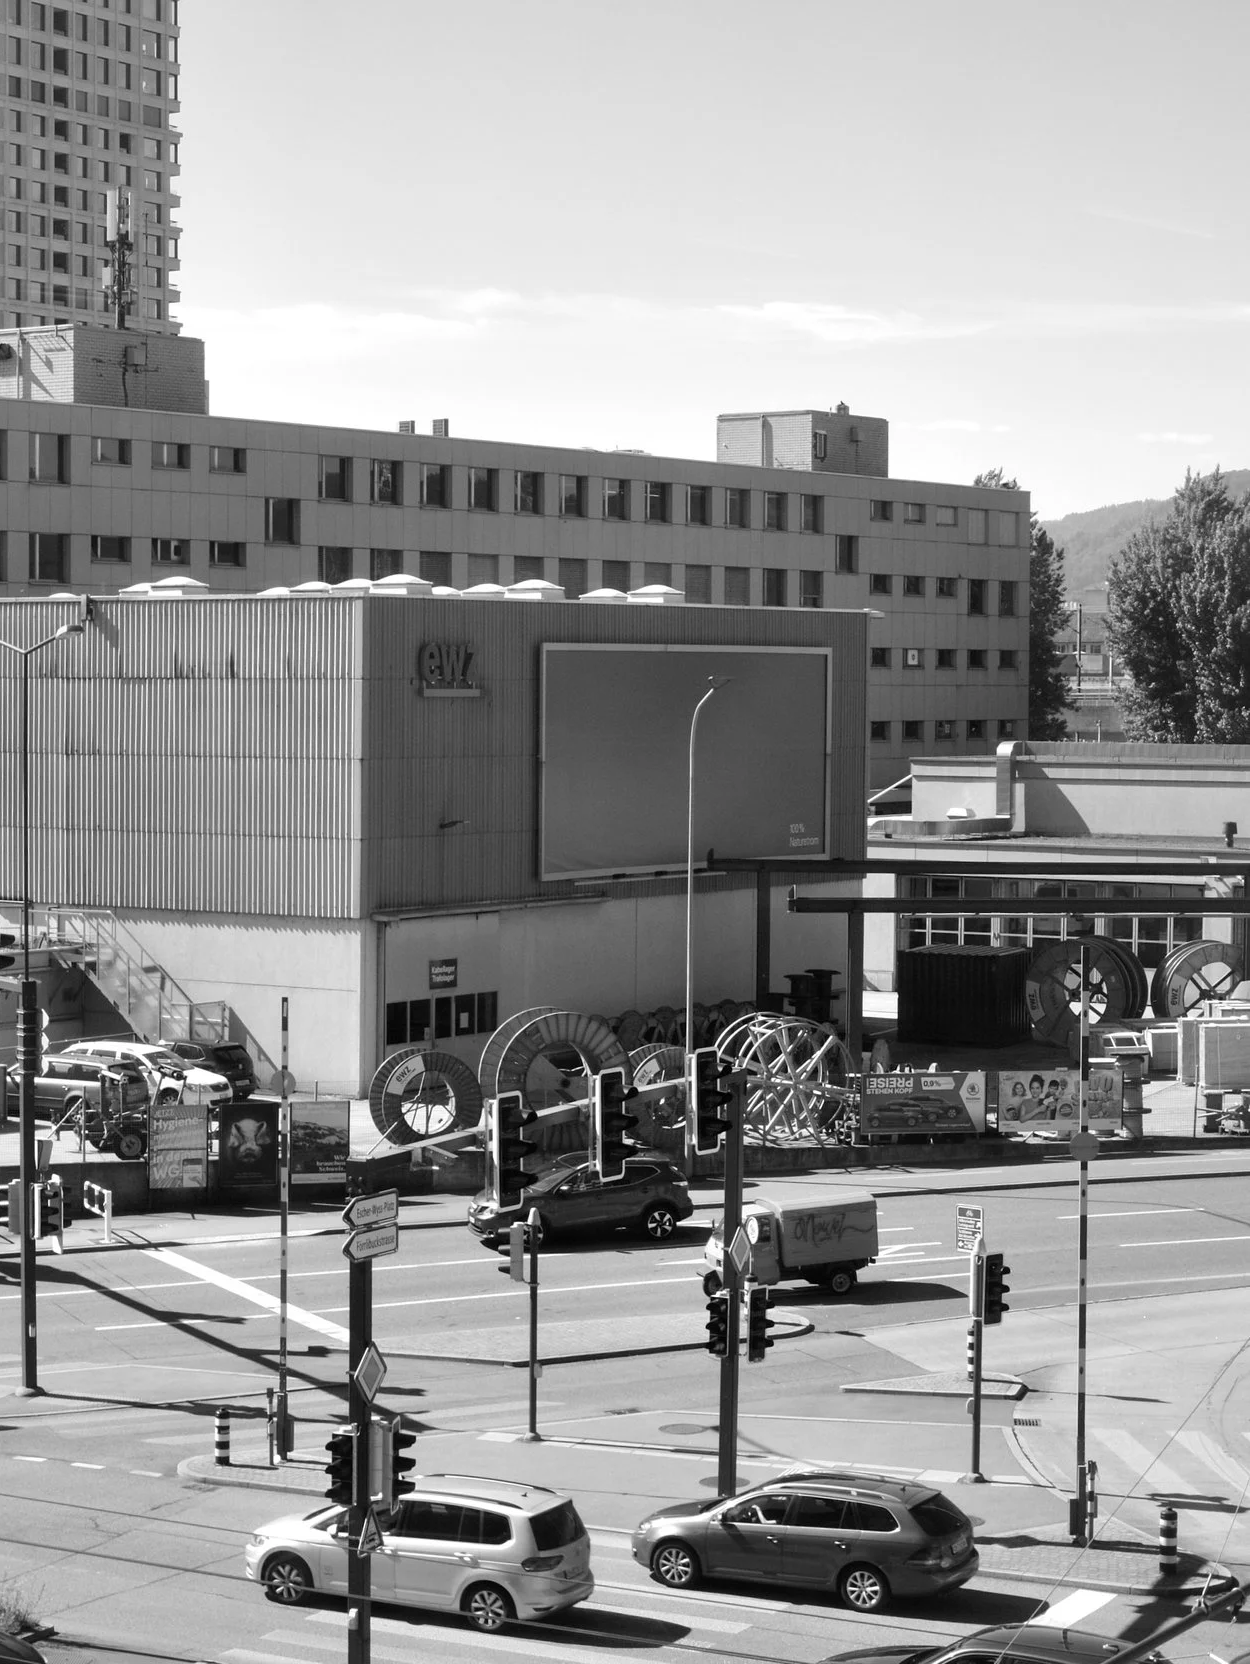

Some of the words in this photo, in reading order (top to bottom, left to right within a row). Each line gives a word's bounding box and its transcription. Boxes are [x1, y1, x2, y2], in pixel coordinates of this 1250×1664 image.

[424, 643, 481, 681] ewz
[1170, 988, 1180, 1007] ewz
[395, 1065, 412, 1084] ewz
[866, 1088, 895, 1096] STEHEN
[895, 1087, 914, 1095] KOPF
